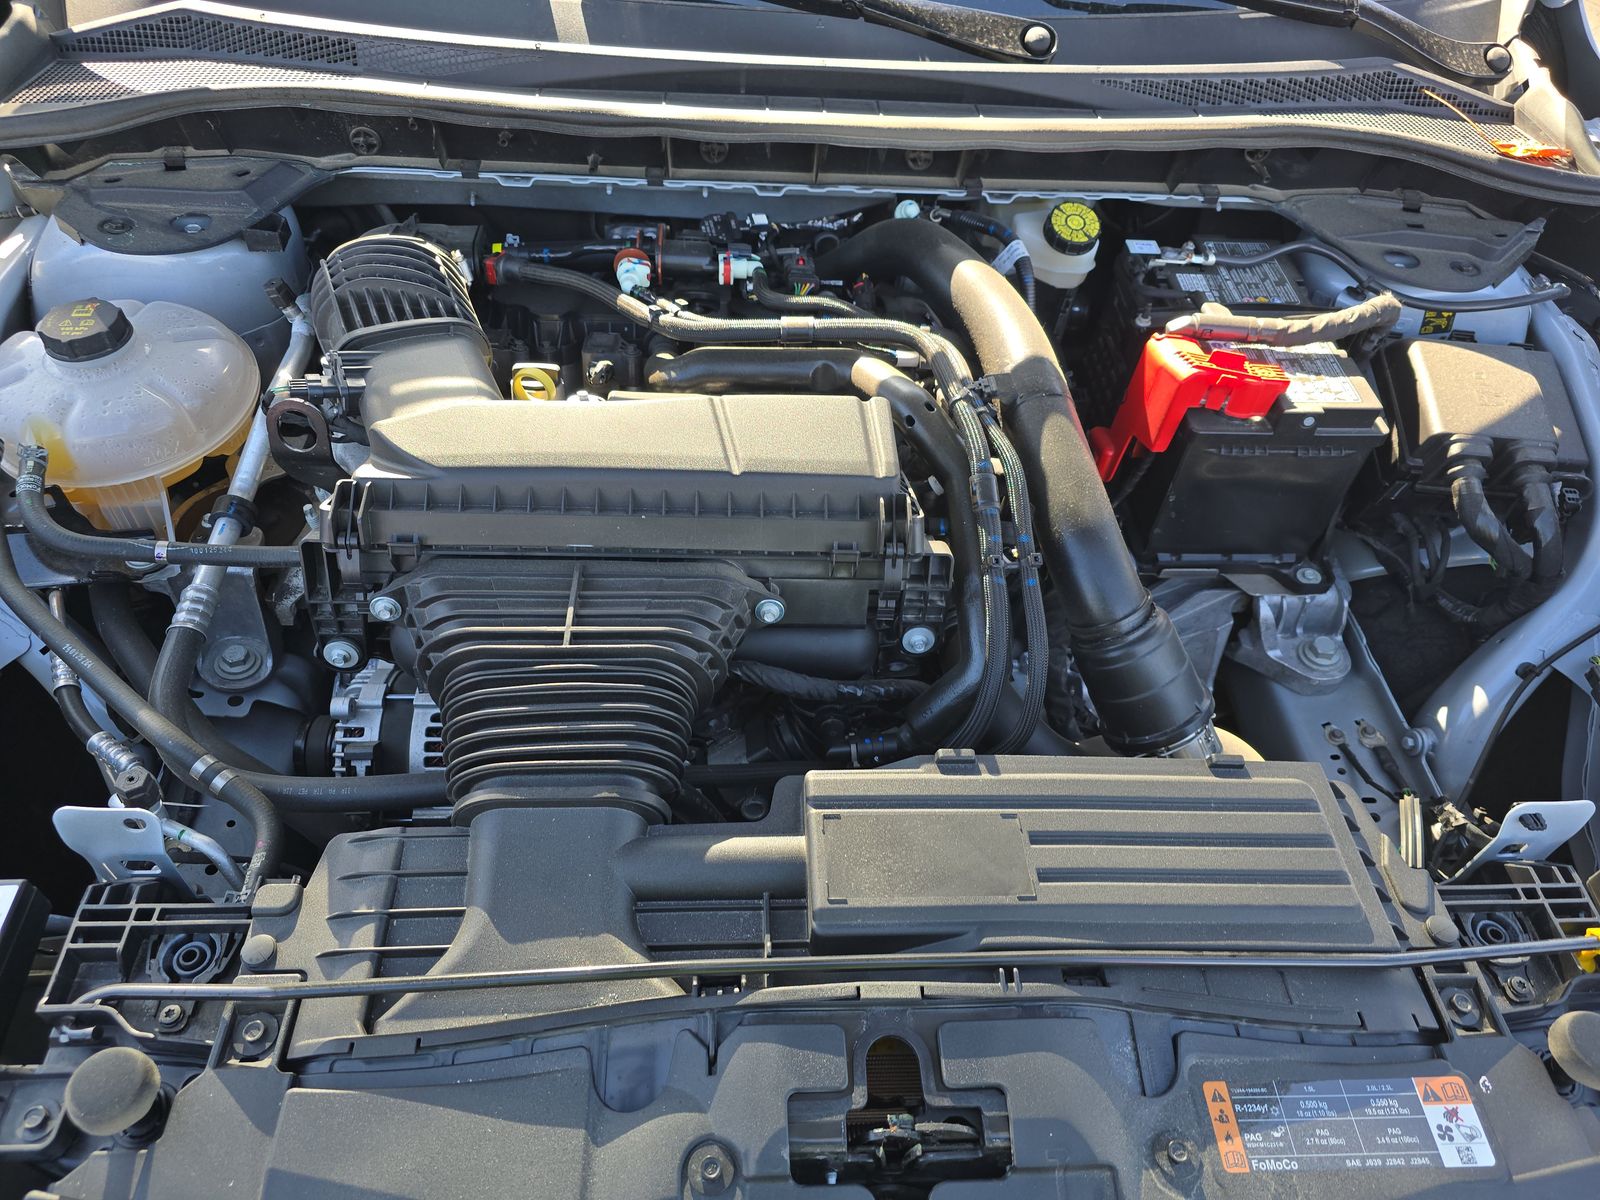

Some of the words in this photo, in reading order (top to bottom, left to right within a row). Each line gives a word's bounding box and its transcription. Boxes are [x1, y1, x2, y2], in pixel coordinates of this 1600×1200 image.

[1318, 1100, 1328, 1110] kg
[1389, 1098, 1399, 1108] kg
[1315, 1128, 1330, 1136] PAG
[1387, 1127, 1402, 1135] PAG
[1244, 1132, 1262, 1142] PAG
[1251, 1158, 1299, 1171] FoMoCo
[1345, 1158, 1362, 1167] SAE
